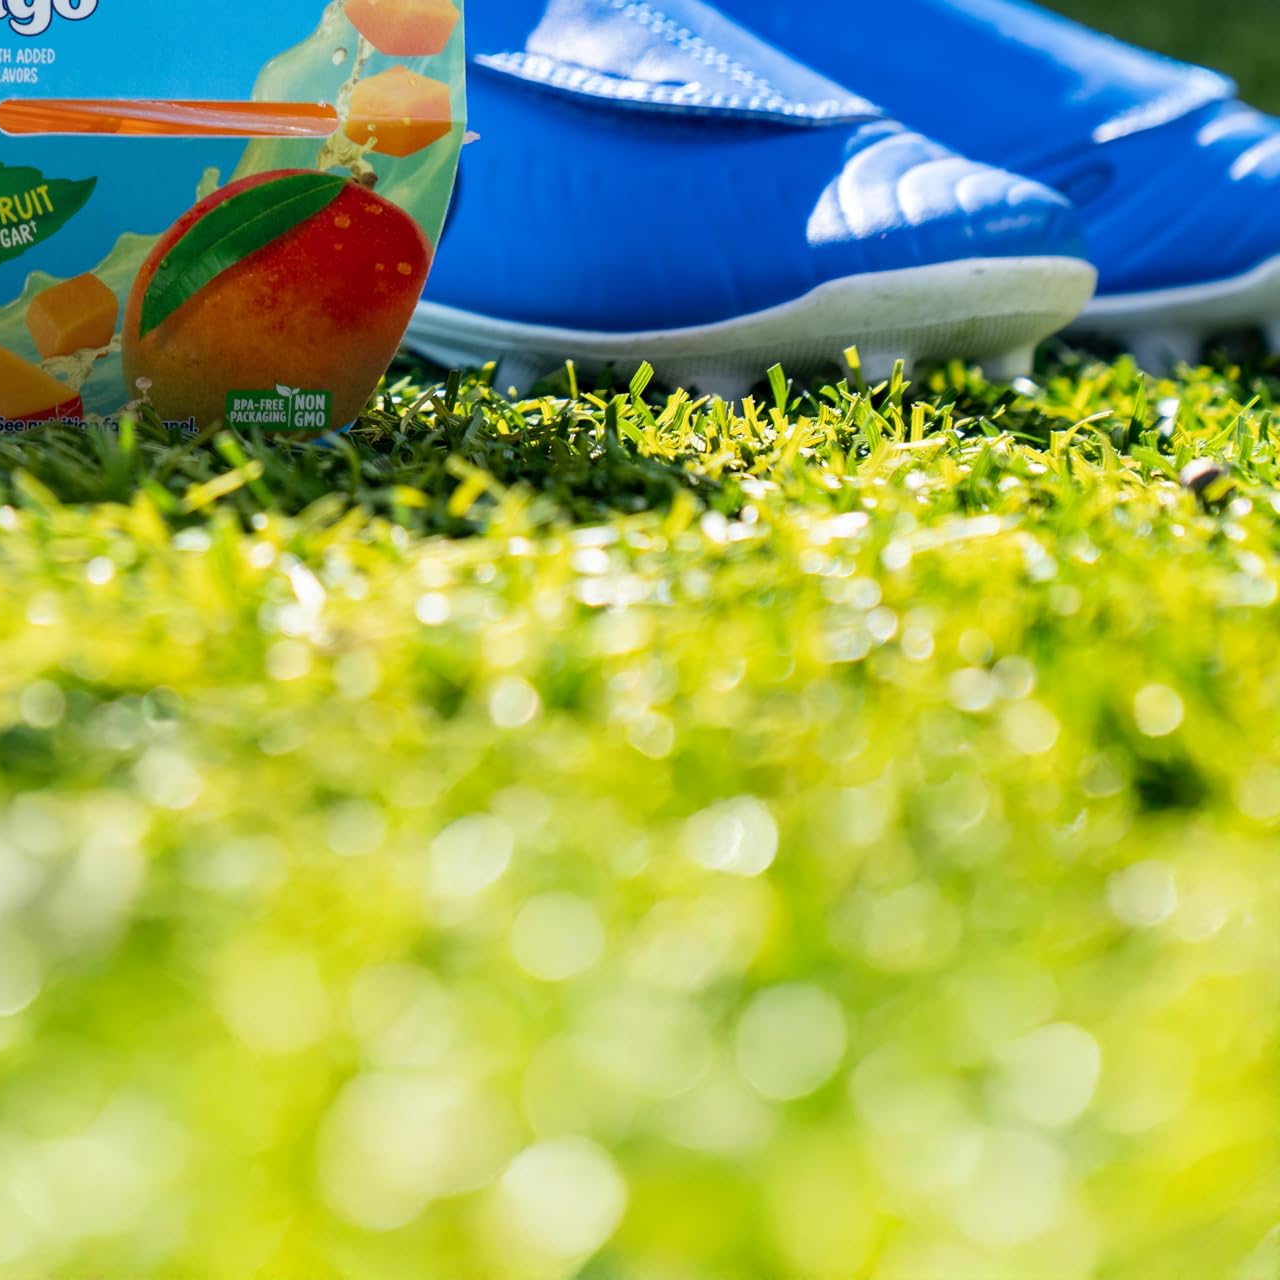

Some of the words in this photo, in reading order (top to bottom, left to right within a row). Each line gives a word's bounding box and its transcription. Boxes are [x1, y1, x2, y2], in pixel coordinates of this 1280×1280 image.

[16, 48, 55, 64] ADDED
[233, 399, 285, 411] BPA-FREE
[294, 394, 326, 410] NON
[230, 411, 287, 423] PACKAGING
[294, 411, 326, 427] GMO
